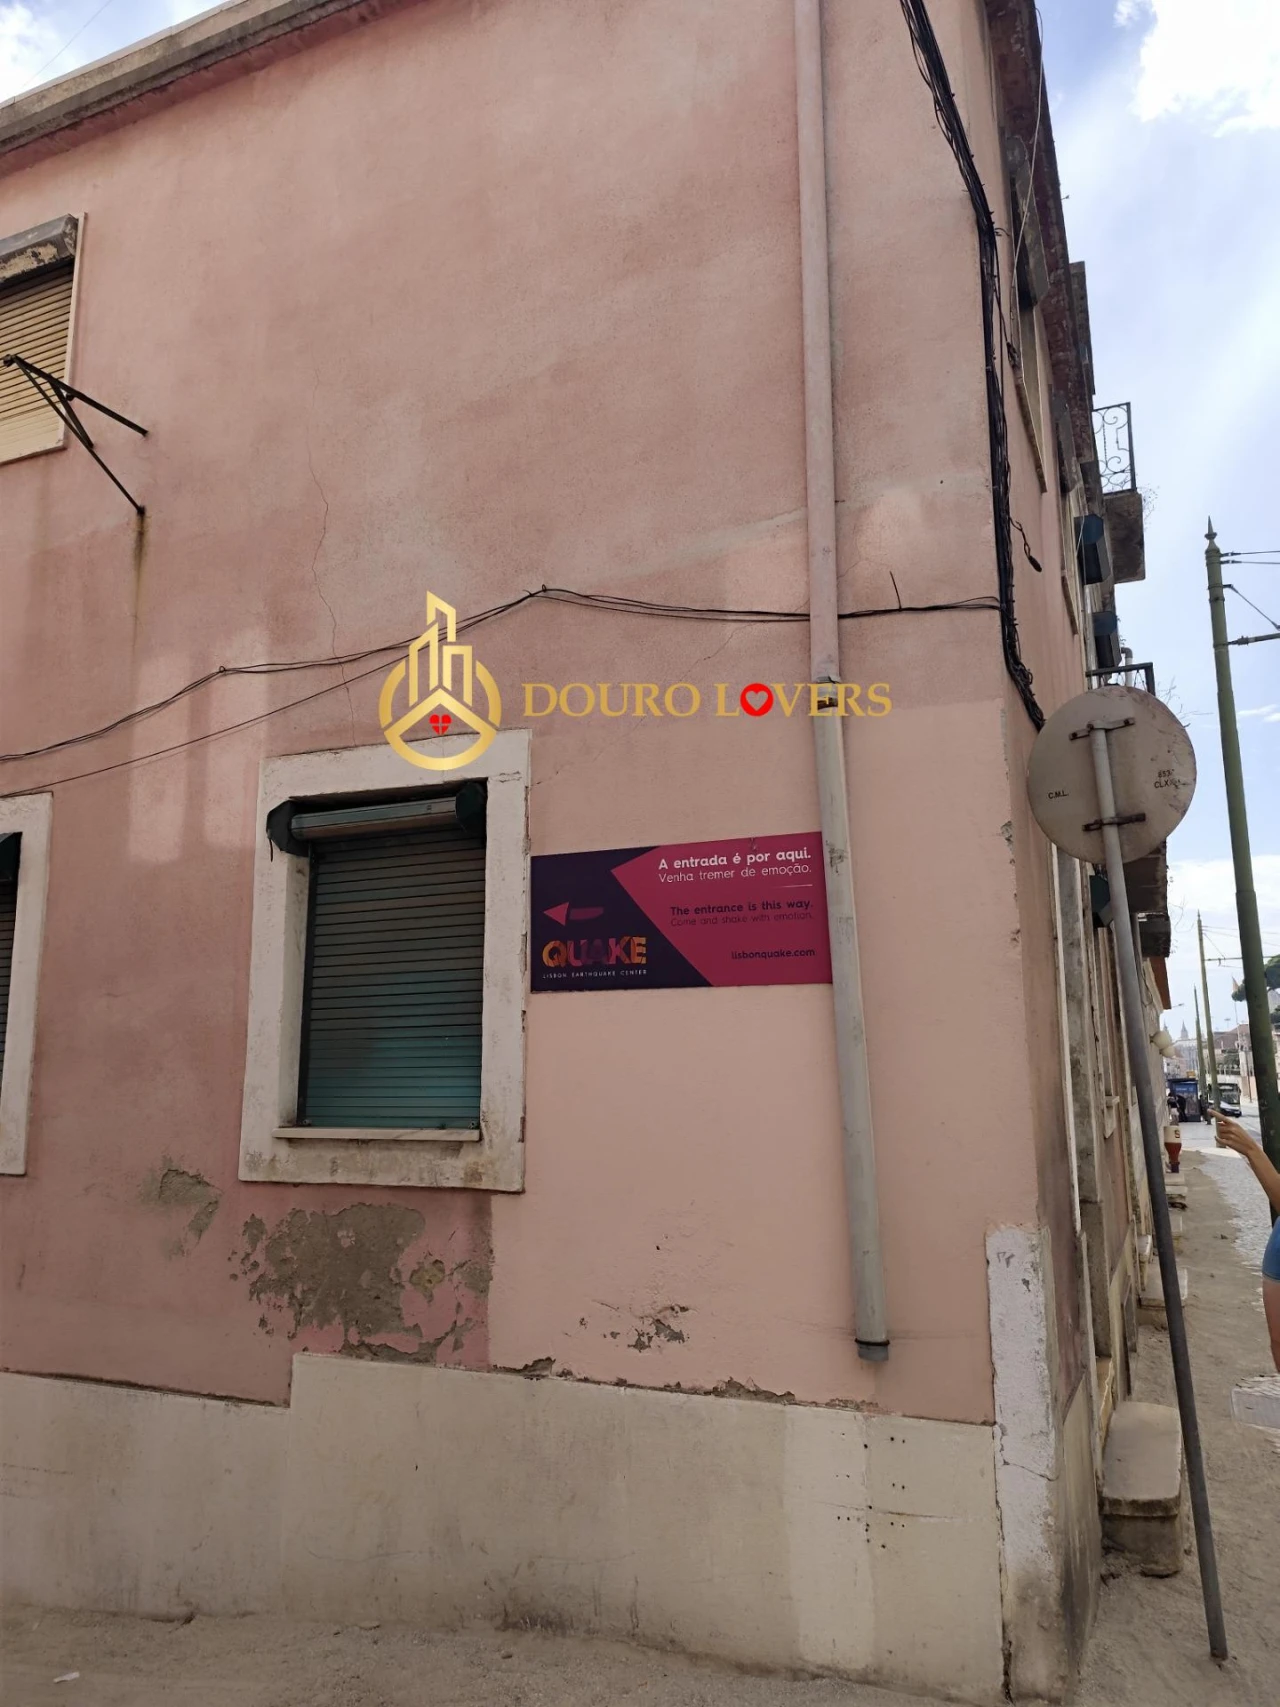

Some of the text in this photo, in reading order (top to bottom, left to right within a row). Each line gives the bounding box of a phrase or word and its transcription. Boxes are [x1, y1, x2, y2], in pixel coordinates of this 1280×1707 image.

[658, 847, 811, 870] A entrada é por aqui.
[658, 864, 812, 883] Venha tremer de emoção.
[670, 900, 813, 916] The entrance is this way.
[670, 918, 697, 927] Come
[700, 916, 718, 925] and
[721, 914, 748, 924] shake
[752, 913, 770, 922] with
[542, 936, 646, 968] QUAKE
[732, 949, 816, 961] lisbonquake.com
[571, 970, 616, 978] EARTHQUAKE
